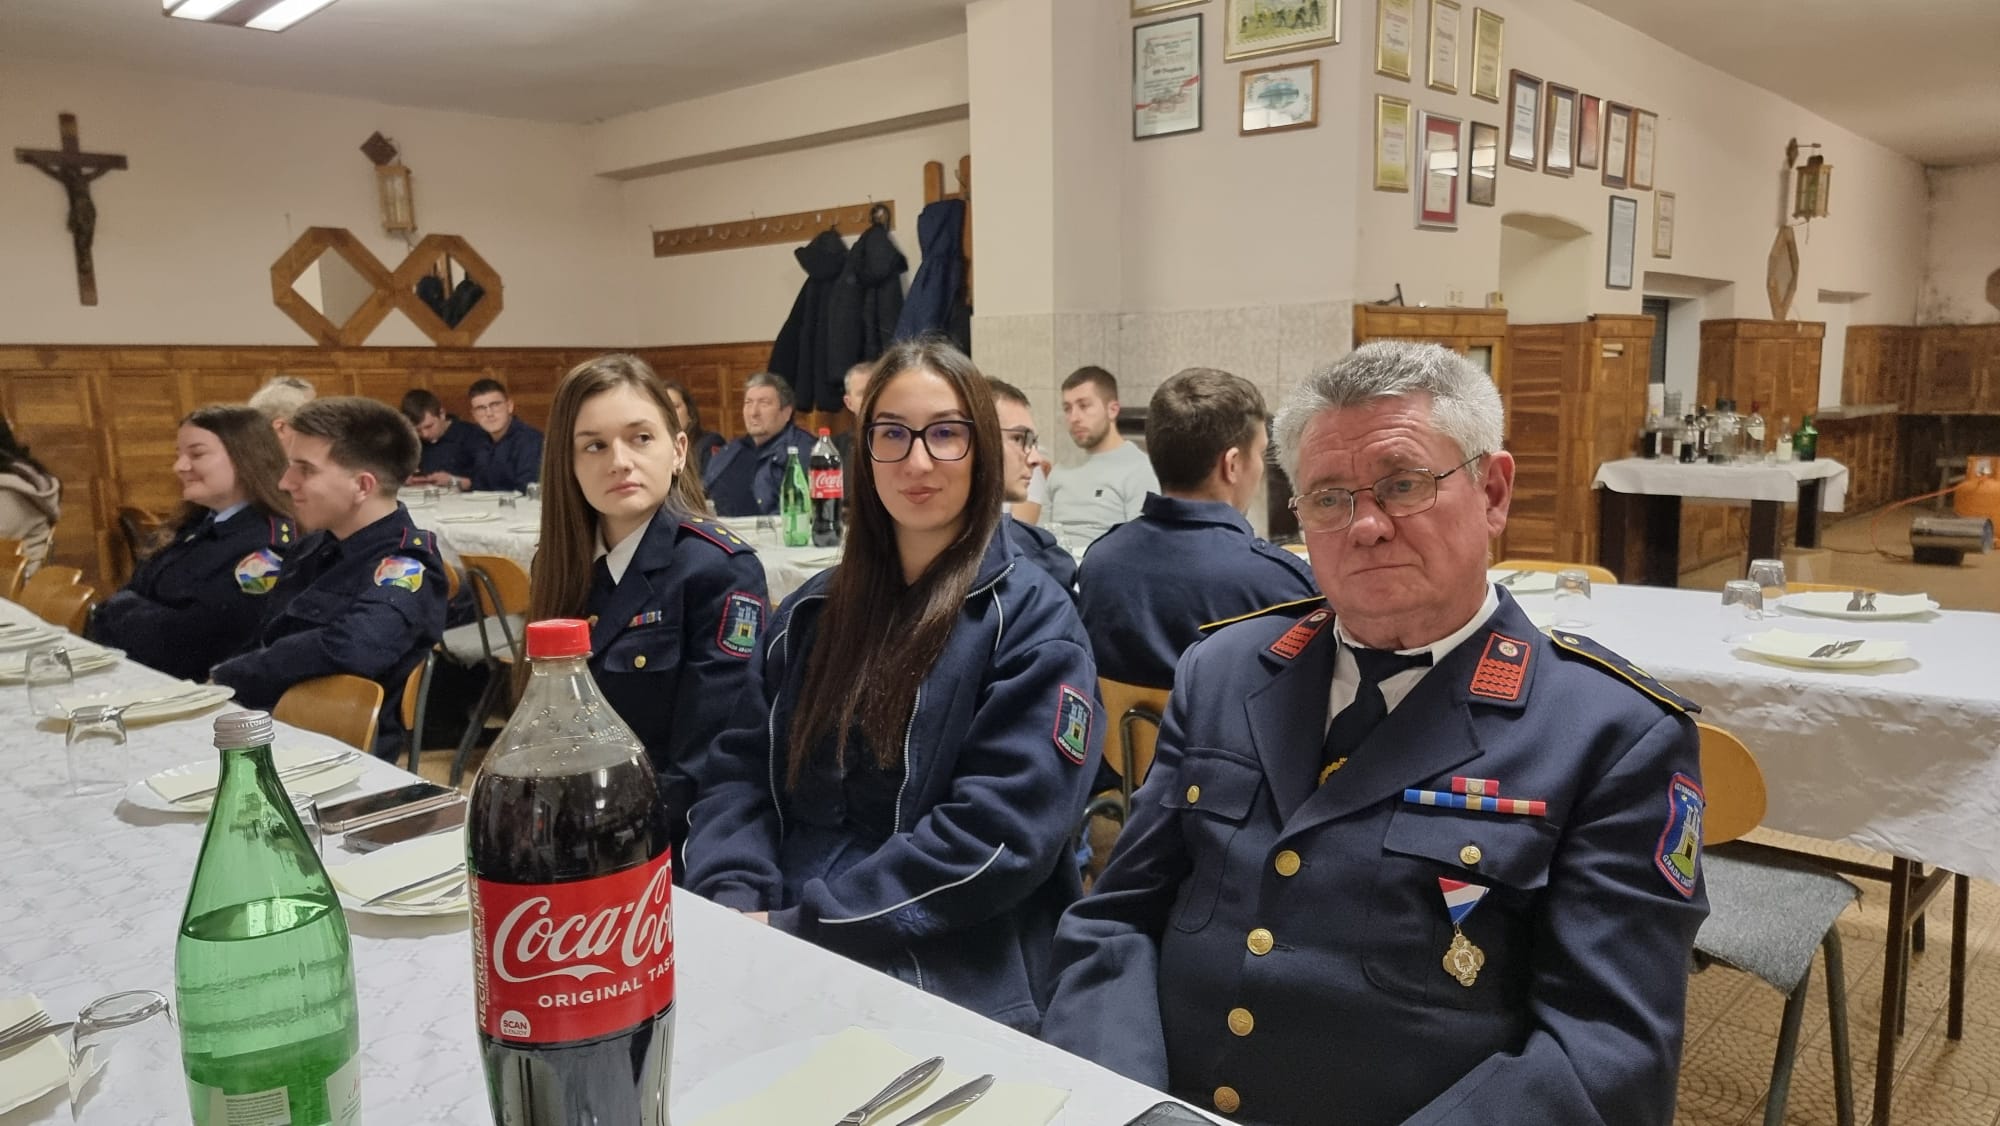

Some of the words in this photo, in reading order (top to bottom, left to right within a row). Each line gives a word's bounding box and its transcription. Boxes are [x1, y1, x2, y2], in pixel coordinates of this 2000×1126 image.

[470, 878, 480, 912] ME
[473, 915, 487, 1028] RECIKLIRAJ
[538, 976, 643, 1008] ORIGINAL
[503, 1019, 528, 1030] SCAN
